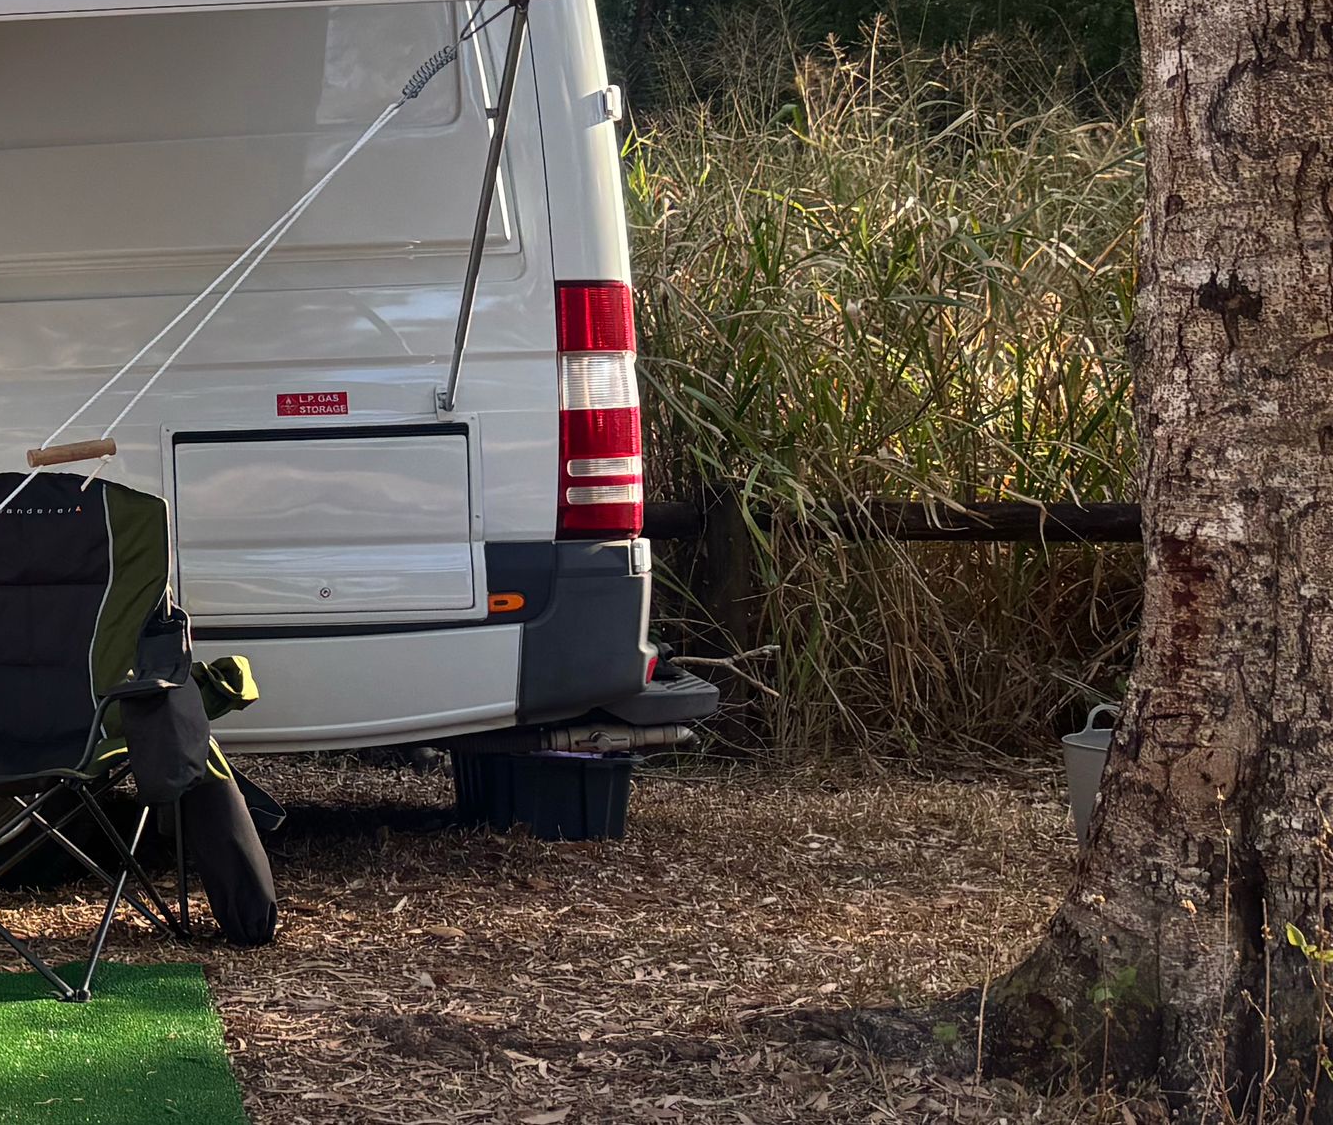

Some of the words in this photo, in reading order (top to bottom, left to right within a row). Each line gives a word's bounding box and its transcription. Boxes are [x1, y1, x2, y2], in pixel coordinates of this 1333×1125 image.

[299, 395, 315, 403] L.P.
[317, 394, 339, 403] GAS
[299, 405, 347, 414] STORAGE
